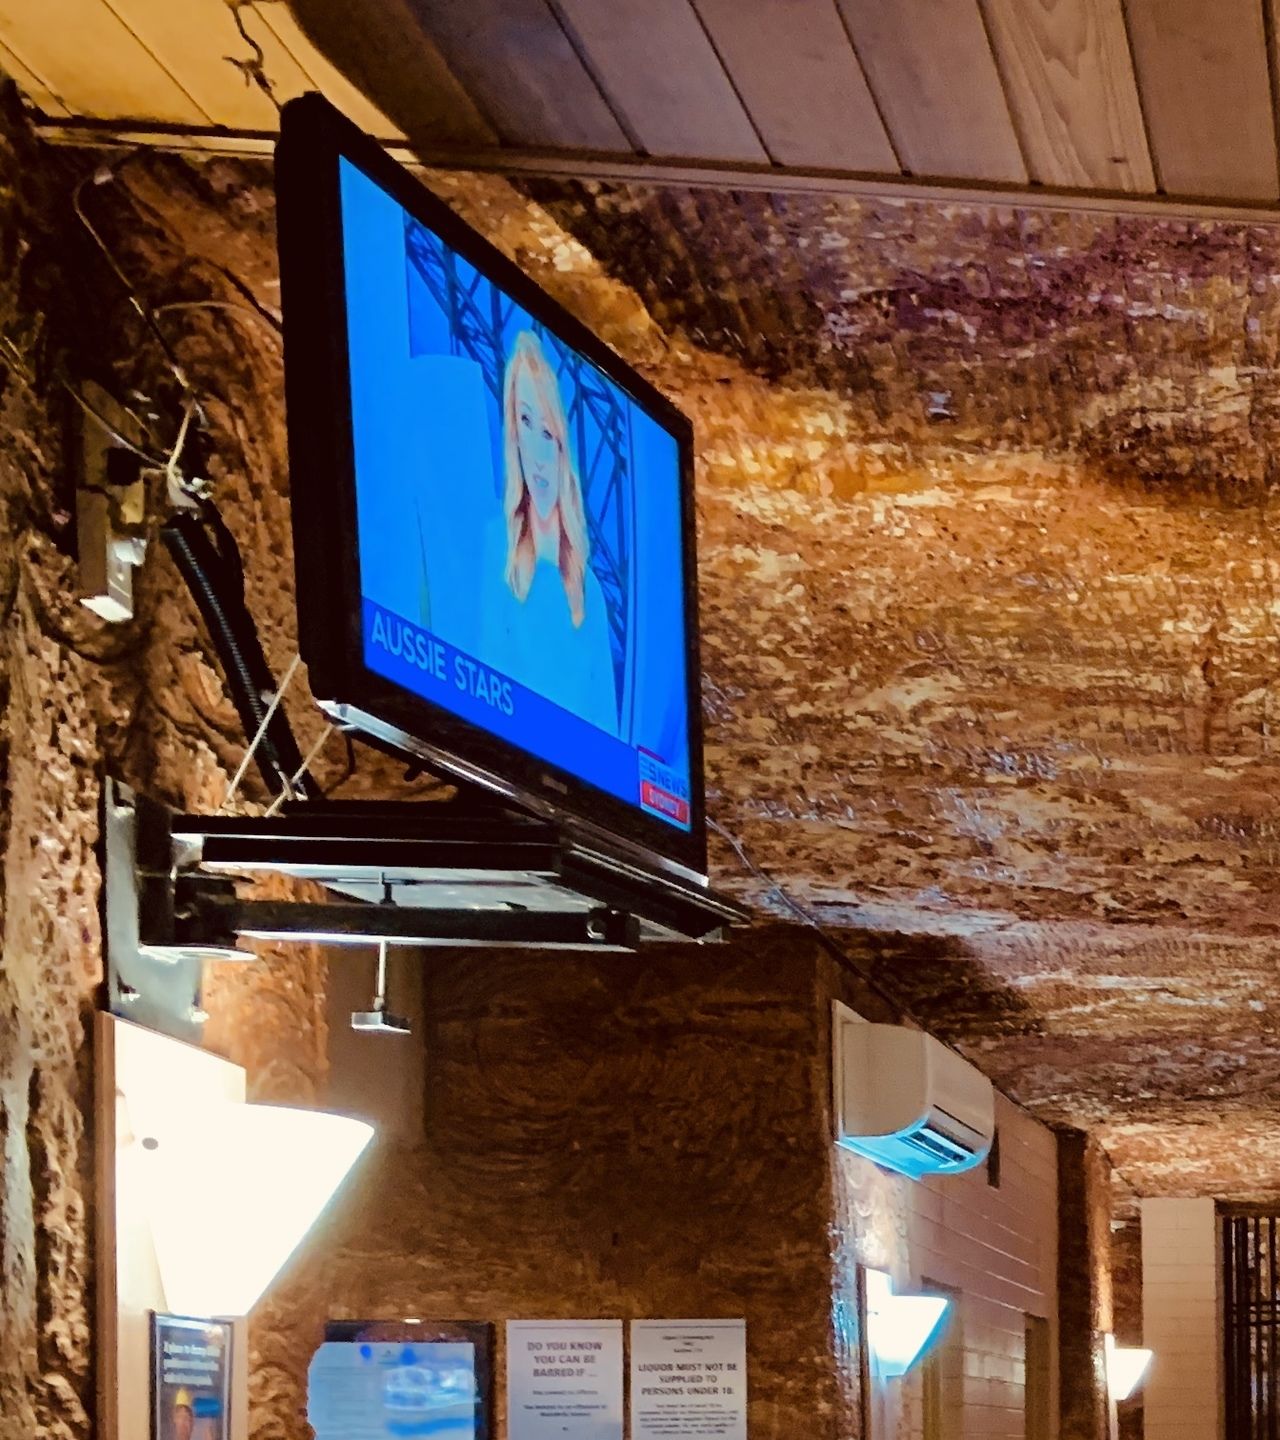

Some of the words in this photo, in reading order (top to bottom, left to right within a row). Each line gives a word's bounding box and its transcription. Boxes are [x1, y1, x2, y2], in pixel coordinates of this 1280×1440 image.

[371, 611, 448, 681] AUSSIE
[454, 655, 514, 716] STARS
[527, 1341, 543, 1351] DO
[546, 1342, 567, 1351] YOU
[570, 1341, 602, 1351] KNOW
[534, 1355, 556, 1364] YOU
[559, 1355, 580, 1364] CAN
[583, 1355, 596, 1363] BE
[638, 1363, 673, 1372] LIQUOR
[676, 1363, 702, 1371] MUST
[705, 1363, 723, 1371] NOT
[726, 1363, 738, 1371] BE
[533, 1368, 574, 1377] BARRED
[705, 1374, 718, 1383] TO
[641, 1387, 684, 1395] PERSONS
[686, 1387, 719, 1395] UNDER
